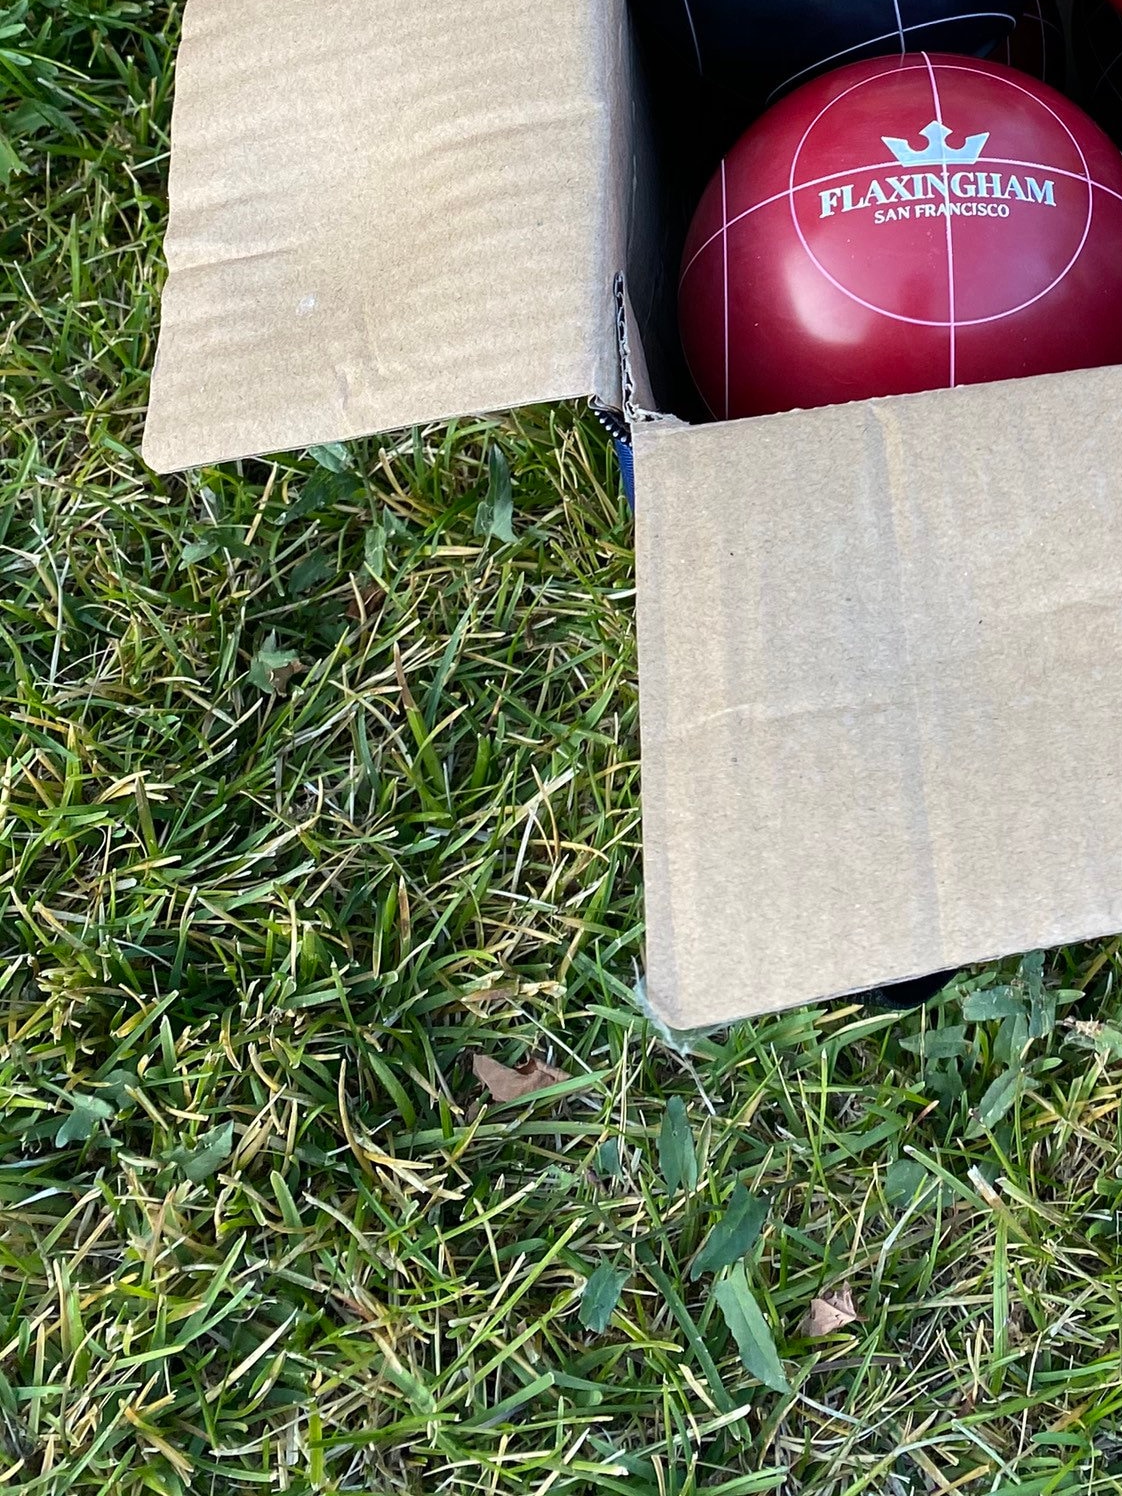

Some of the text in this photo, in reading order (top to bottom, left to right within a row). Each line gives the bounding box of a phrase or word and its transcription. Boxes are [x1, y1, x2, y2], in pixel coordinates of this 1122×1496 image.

[818, 171, 1057, 219] FLAXINGHAM
[874, 202, 1010, 224] SAN FRANCISCO
